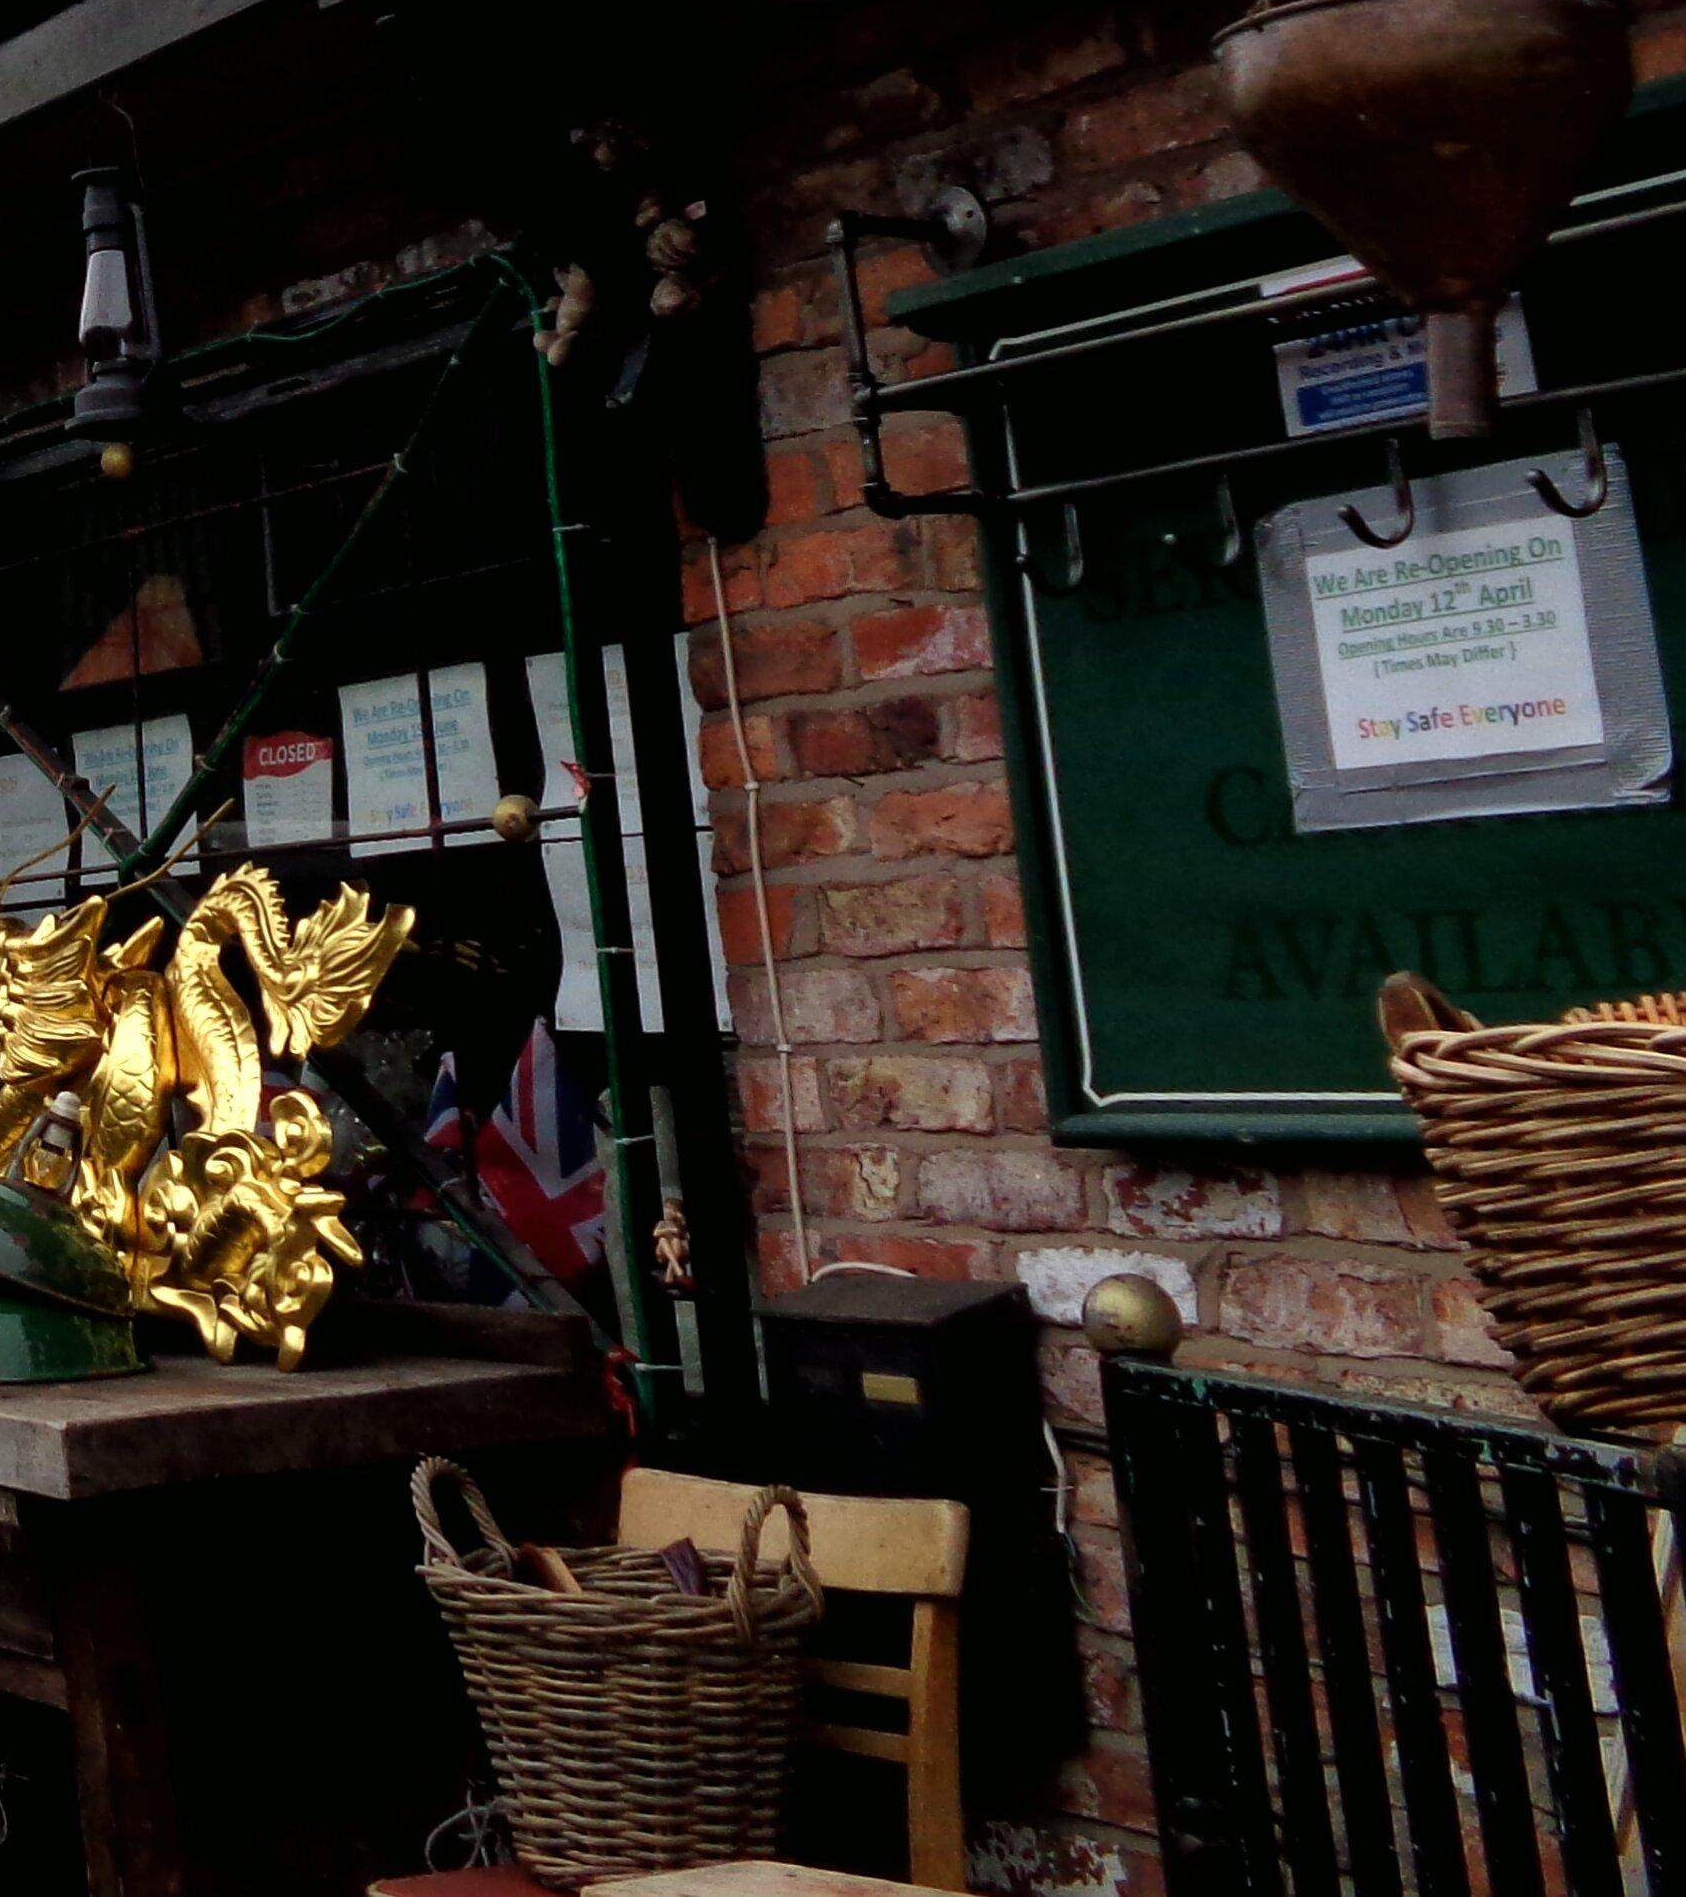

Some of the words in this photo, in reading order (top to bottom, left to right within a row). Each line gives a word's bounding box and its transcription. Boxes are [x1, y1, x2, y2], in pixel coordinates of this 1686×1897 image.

[1314, 572, 1348, 597] We
[1353, 565, 1389, 589] Are
[1393, 540, 1523, 579] Re-Opening
[1528, 536, 1562, 558] On
[1341, 596, 1424, 629] Monday
[1430, 580, 1473, 614] 12th
[1479, 576, 1534, 607] April
[1337, 635, 1395, 659] Opening
[1397, 629, 1439, 649] Hours
[1442, 624, 1469, 643] Are
[1383, 656, 1424, 674] Times
[1427, 651, 1459, 670] May
[1462, 645, 1506, 665] Differ
[1357, 716, 1401, 741] Stay
[1406, 706, 1454, 733] Safe
[1459, 696, 1568, 727] Everyone
[258, 742, 317, 766] CLOSED
[1225, 900, 1686, 1000] AVAILAB
